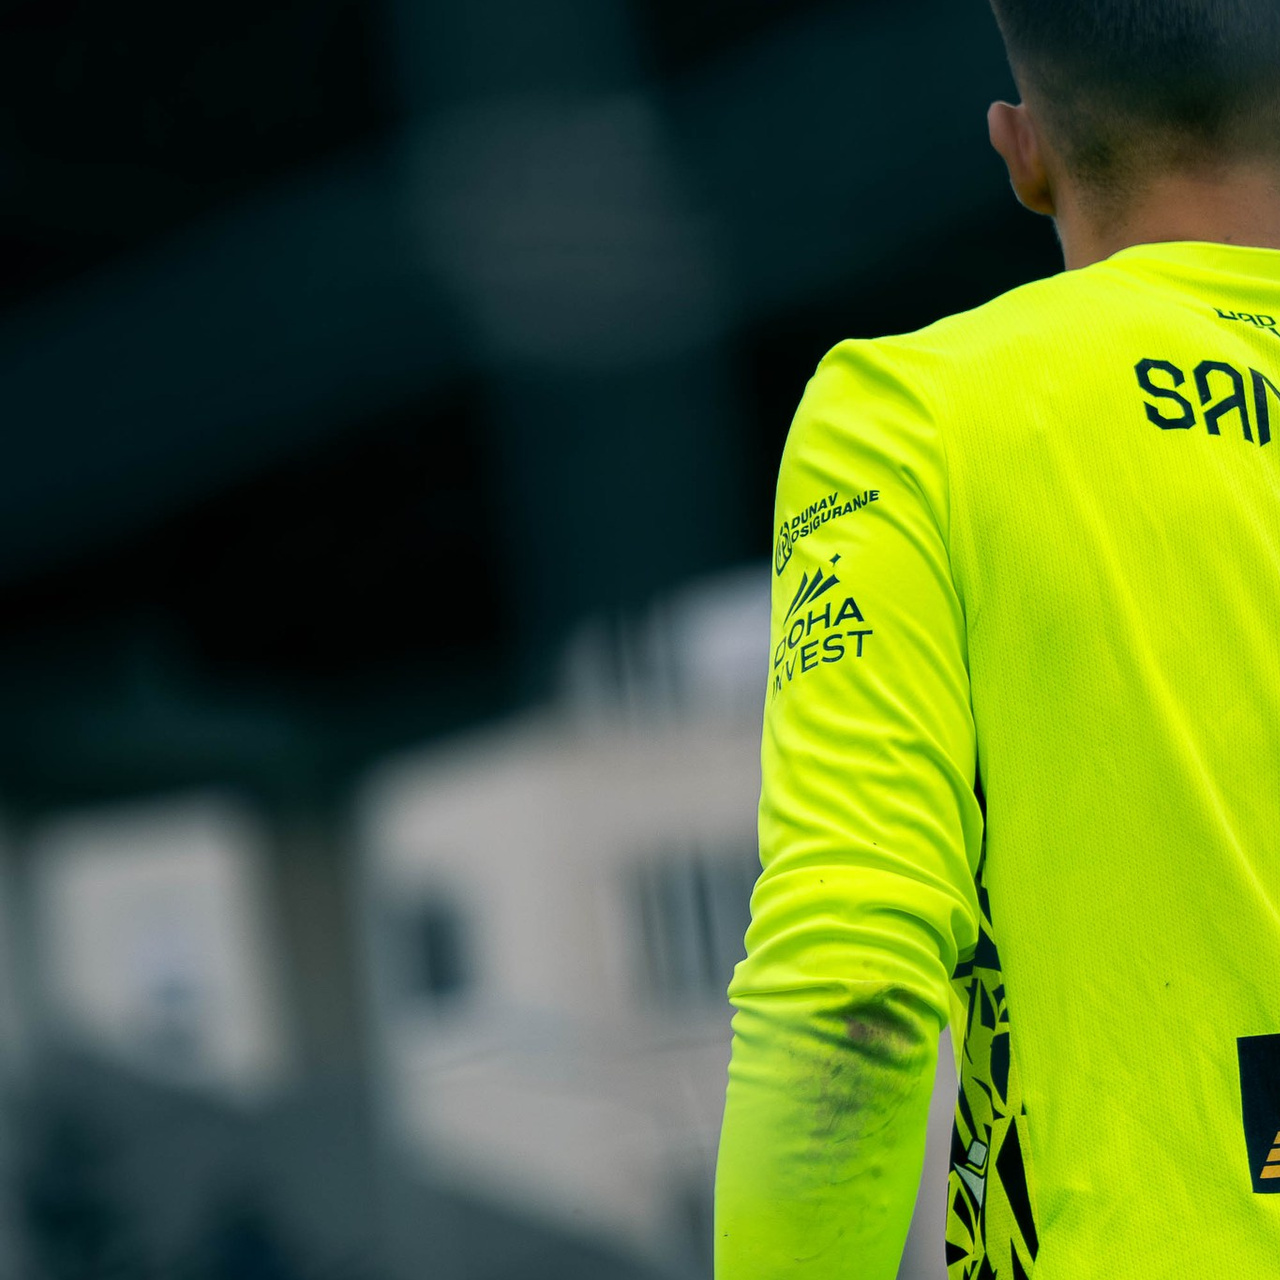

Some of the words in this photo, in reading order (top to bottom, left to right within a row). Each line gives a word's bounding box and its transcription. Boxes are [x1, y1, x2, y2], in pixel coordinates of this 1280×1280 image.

[790, 491, 839, 530] DUNAV
[790, 489, 881, 543] OSIGURANJE
[773, 596, 865, 670] DOHA
